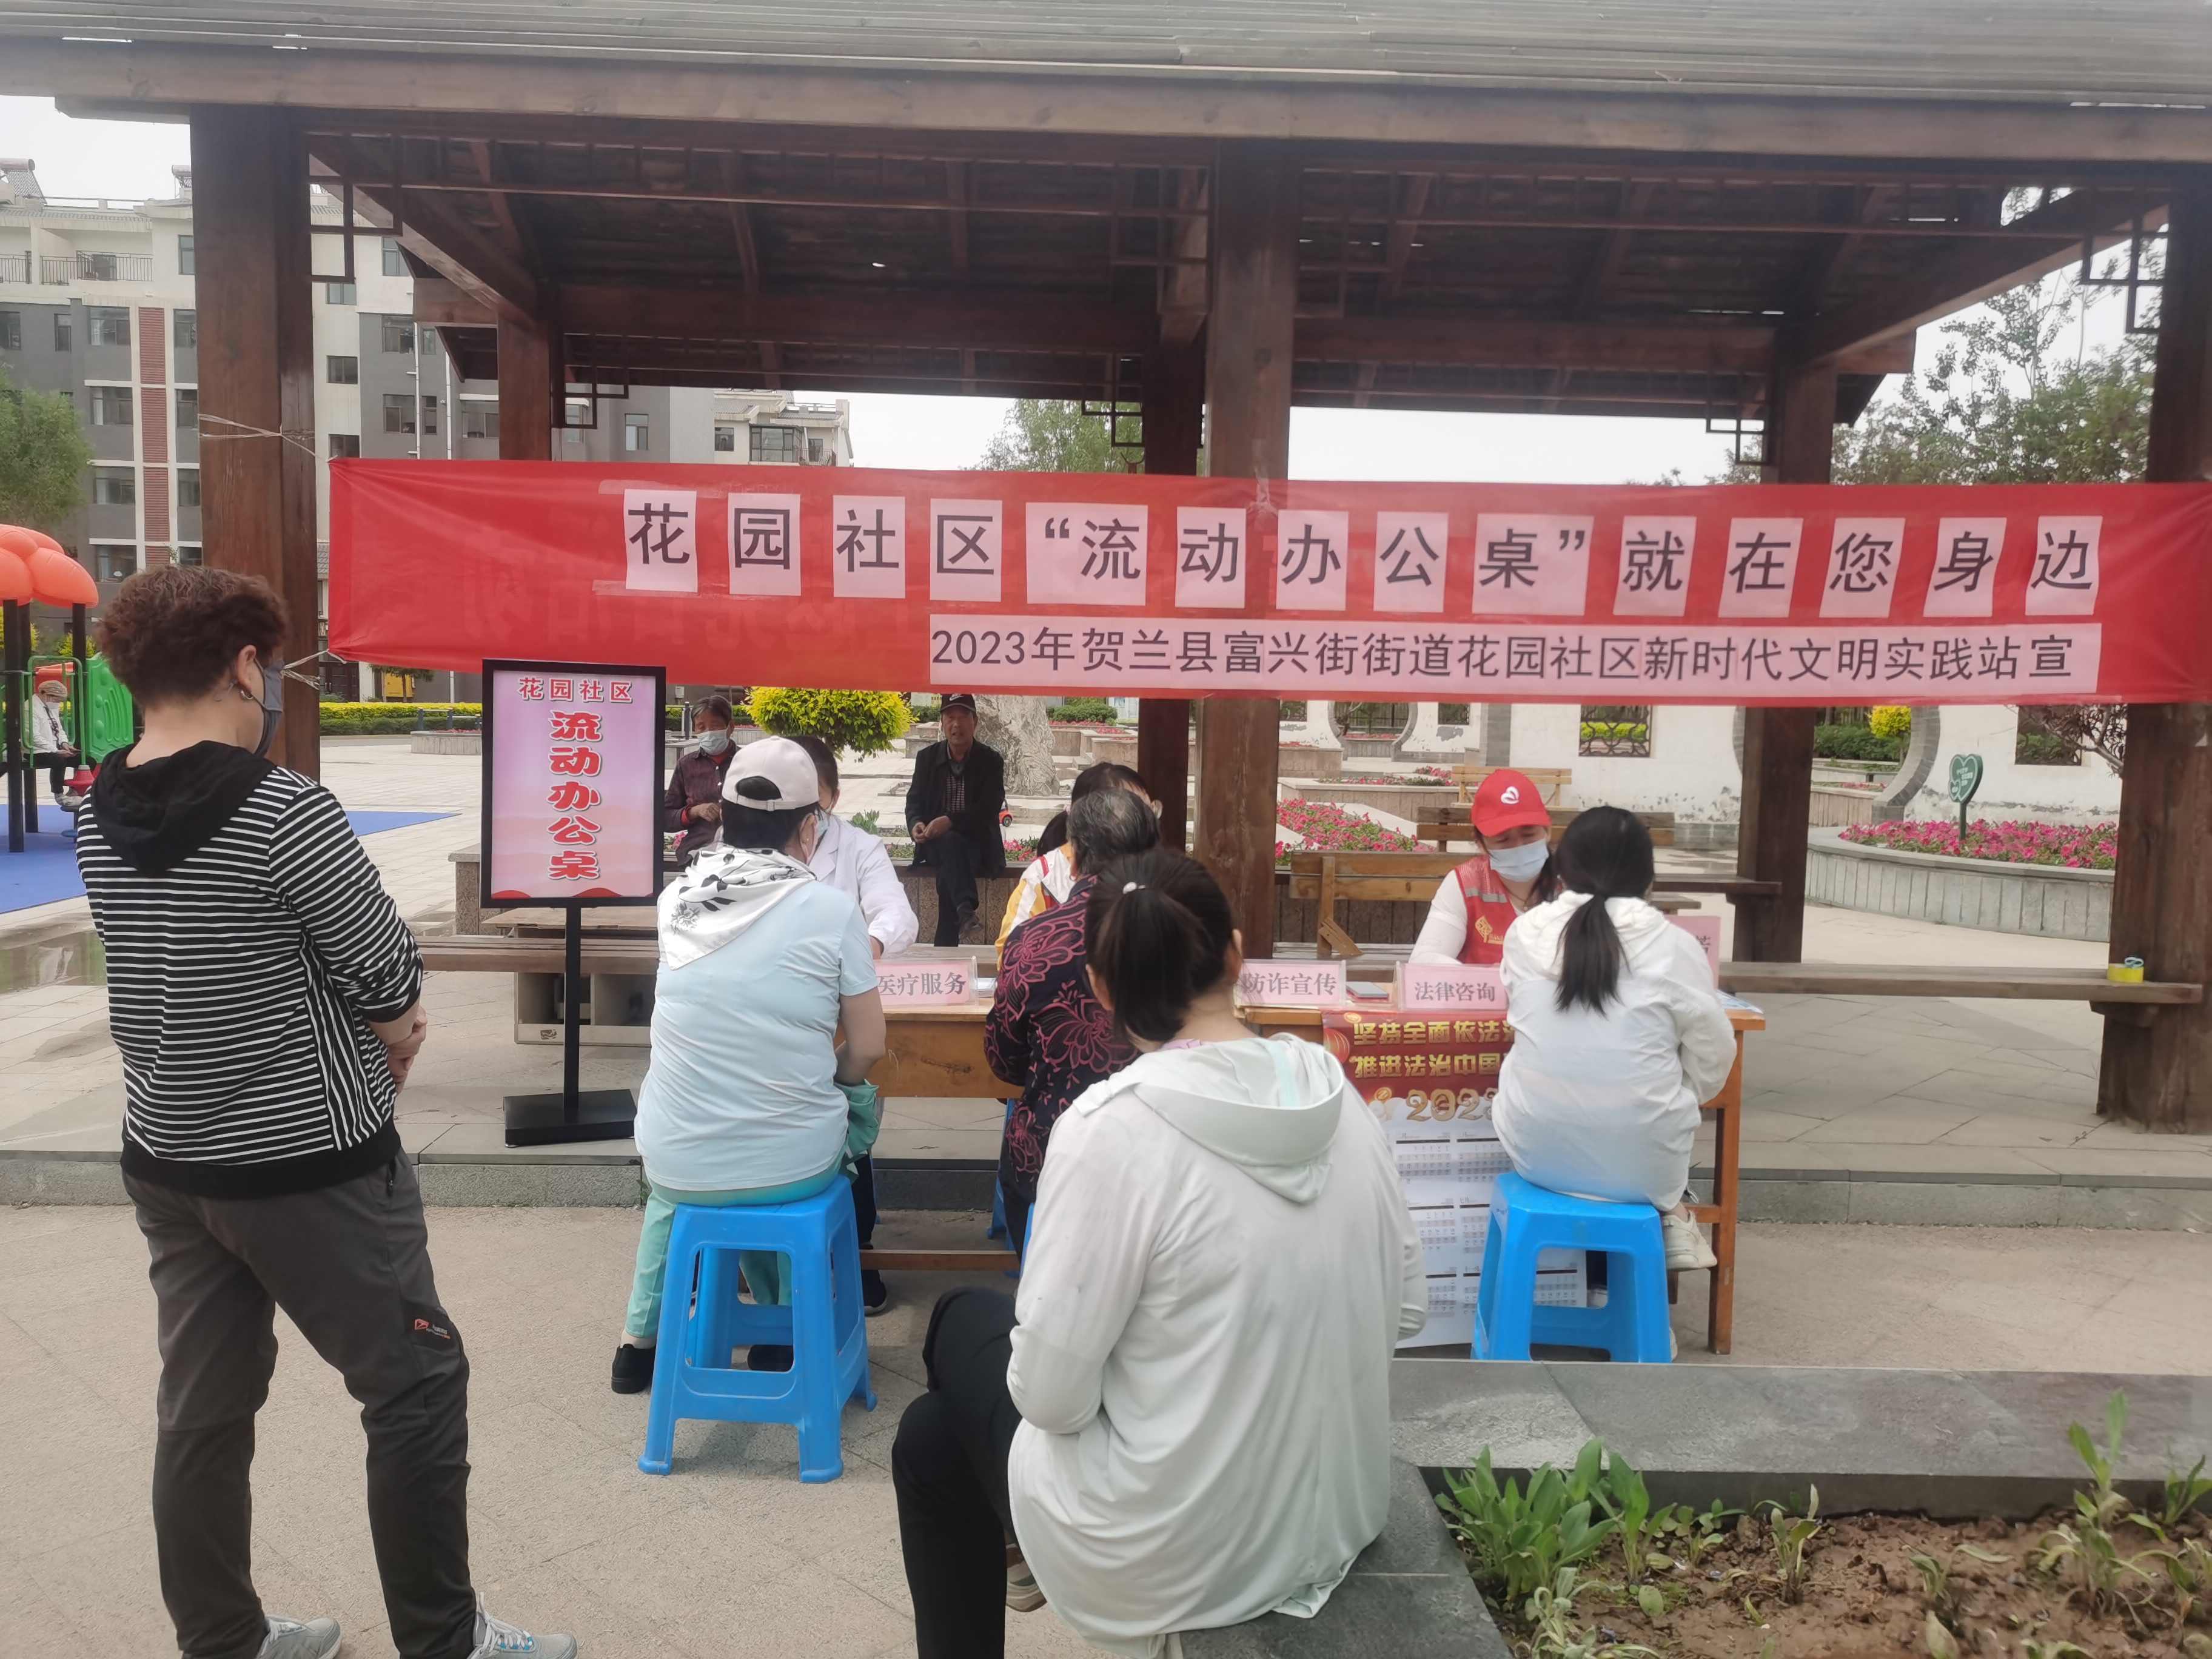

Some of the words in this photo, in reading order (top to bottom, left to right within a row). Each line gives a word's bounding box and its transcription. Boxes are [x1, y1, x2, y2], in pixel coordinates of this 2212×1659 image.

[931, 626, 2073, 680] 2023年贺兰县富兴街街道花园社区新时代文明实践站宣
[518, 677, 632, 702] 花园社区
[547, 710, 602, 879] 流动办公桌
[878, 972, 966, 996] 医疗服务
[1243, 973, 1336, 996] 防诈宣传
[1414, 982, 1495, 1002] 法律咨询
[1354, 1053, 1507, 1078] 推进法治中国
